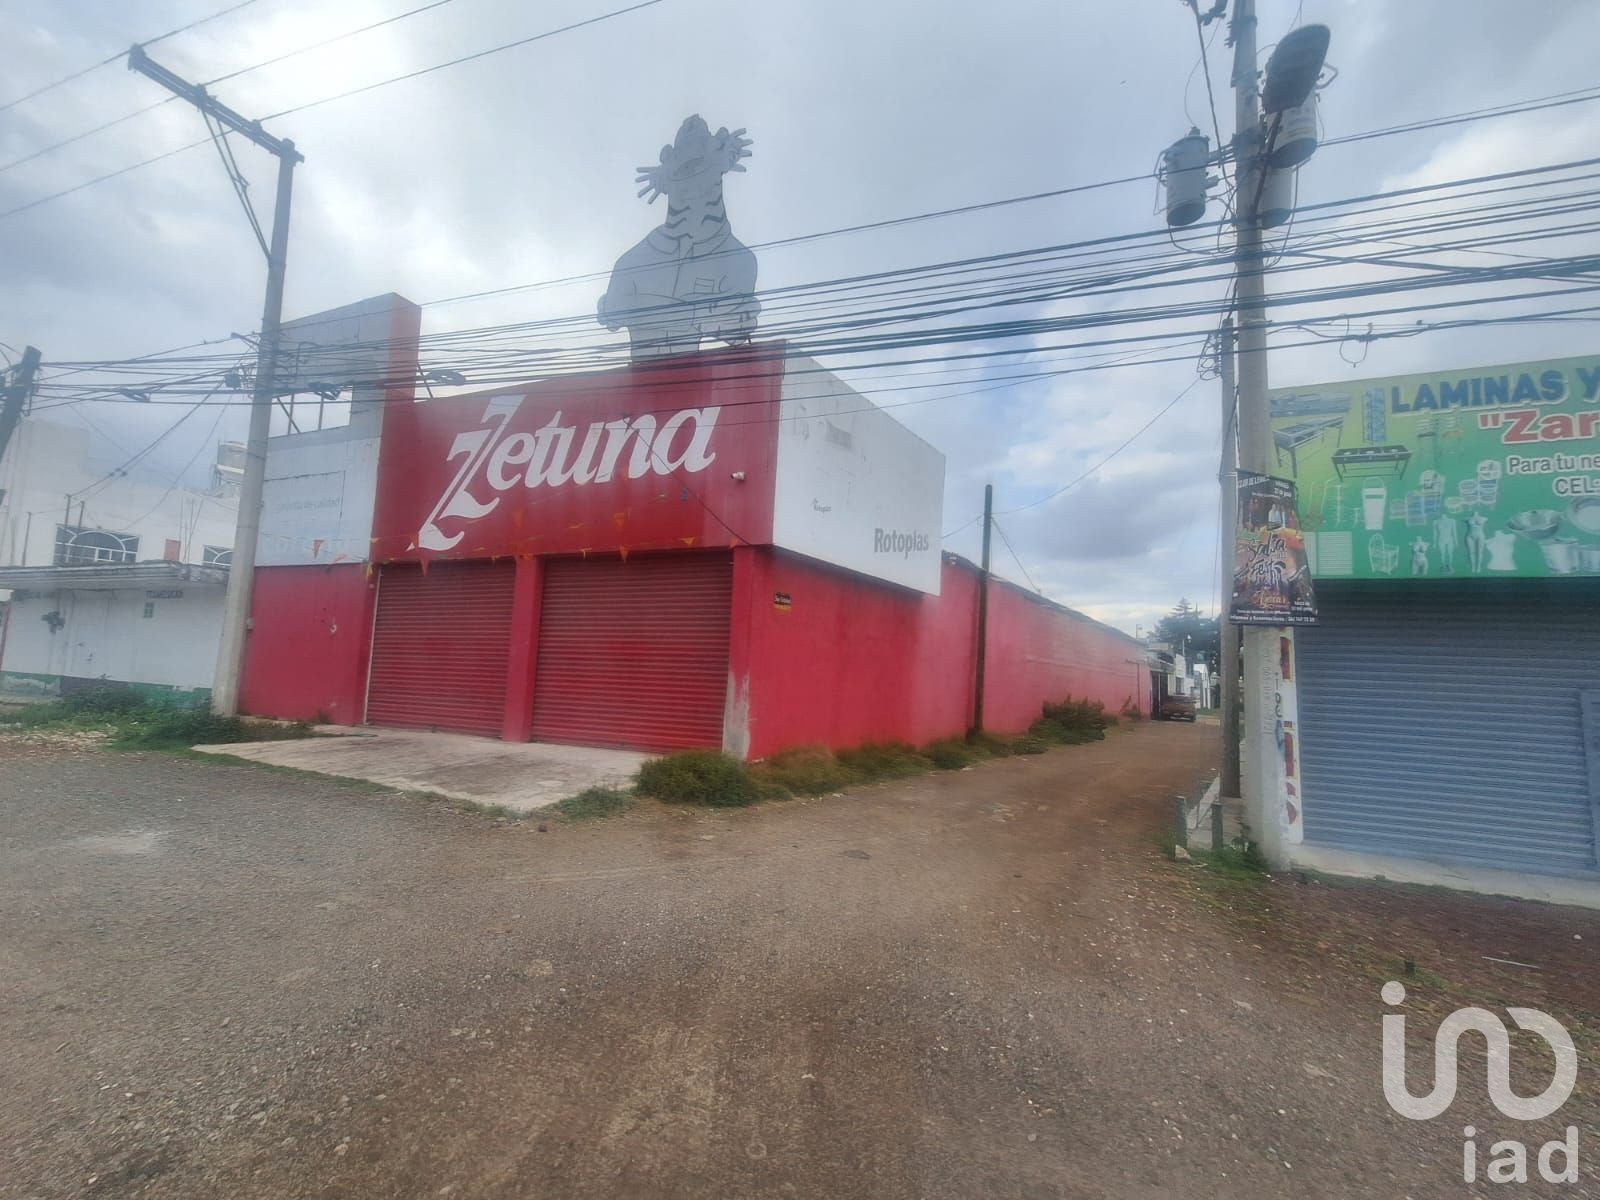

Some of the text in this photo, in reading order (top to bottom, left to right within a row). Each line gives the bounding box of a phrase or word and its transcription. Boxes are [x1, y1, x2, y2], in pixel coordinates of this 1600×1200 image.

[1391, 365, 1600, 414] LAMINAS Y
[405, 393, 721, 552] Zetuna
[1507, 456, 1552, 473] Para
[1556, 454, 1575, 470] tu
[873, 527, 930, 561] Rotoplas
